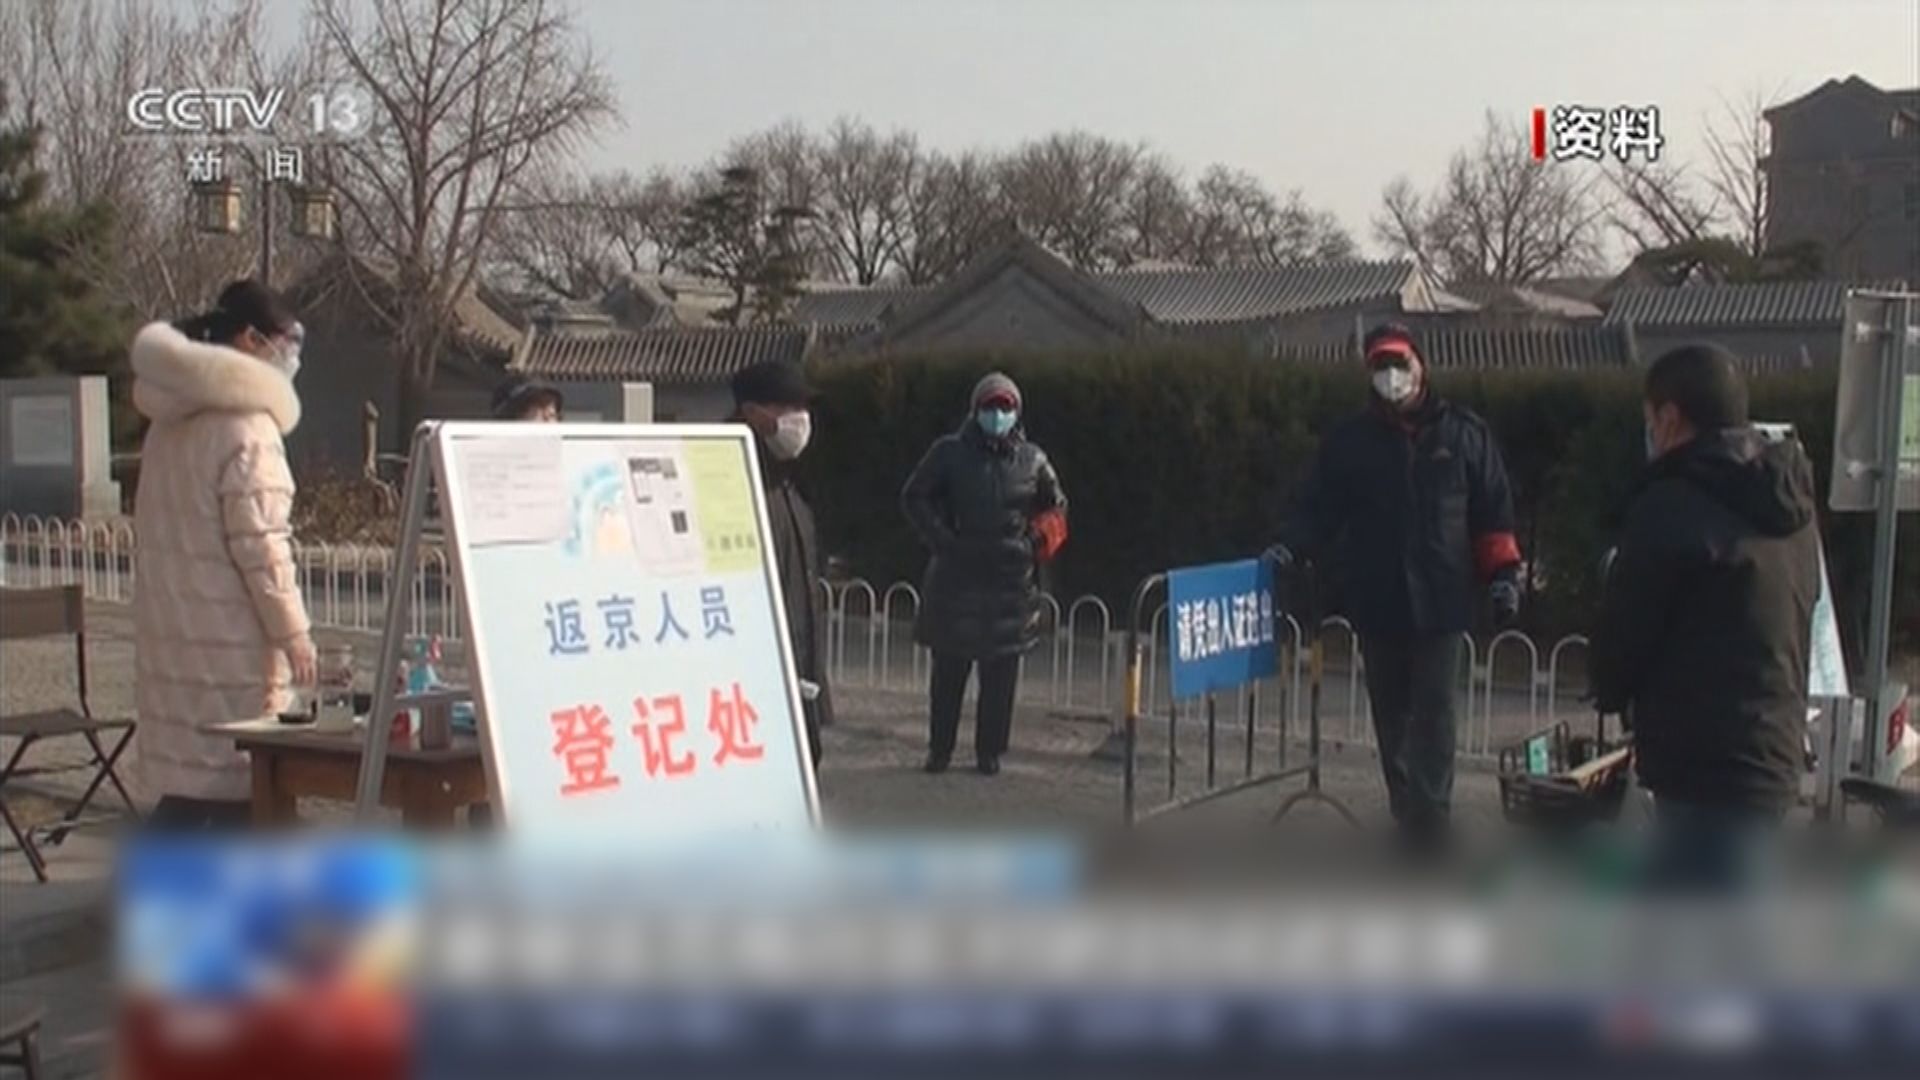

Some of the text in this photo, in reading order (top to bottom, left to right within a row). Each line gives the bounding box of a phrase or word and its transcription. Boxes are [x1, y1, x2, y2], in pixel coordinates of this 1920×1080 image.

[543, 586, 736, 656] 返京人员
[550, 682, 766, 797] 登记处
